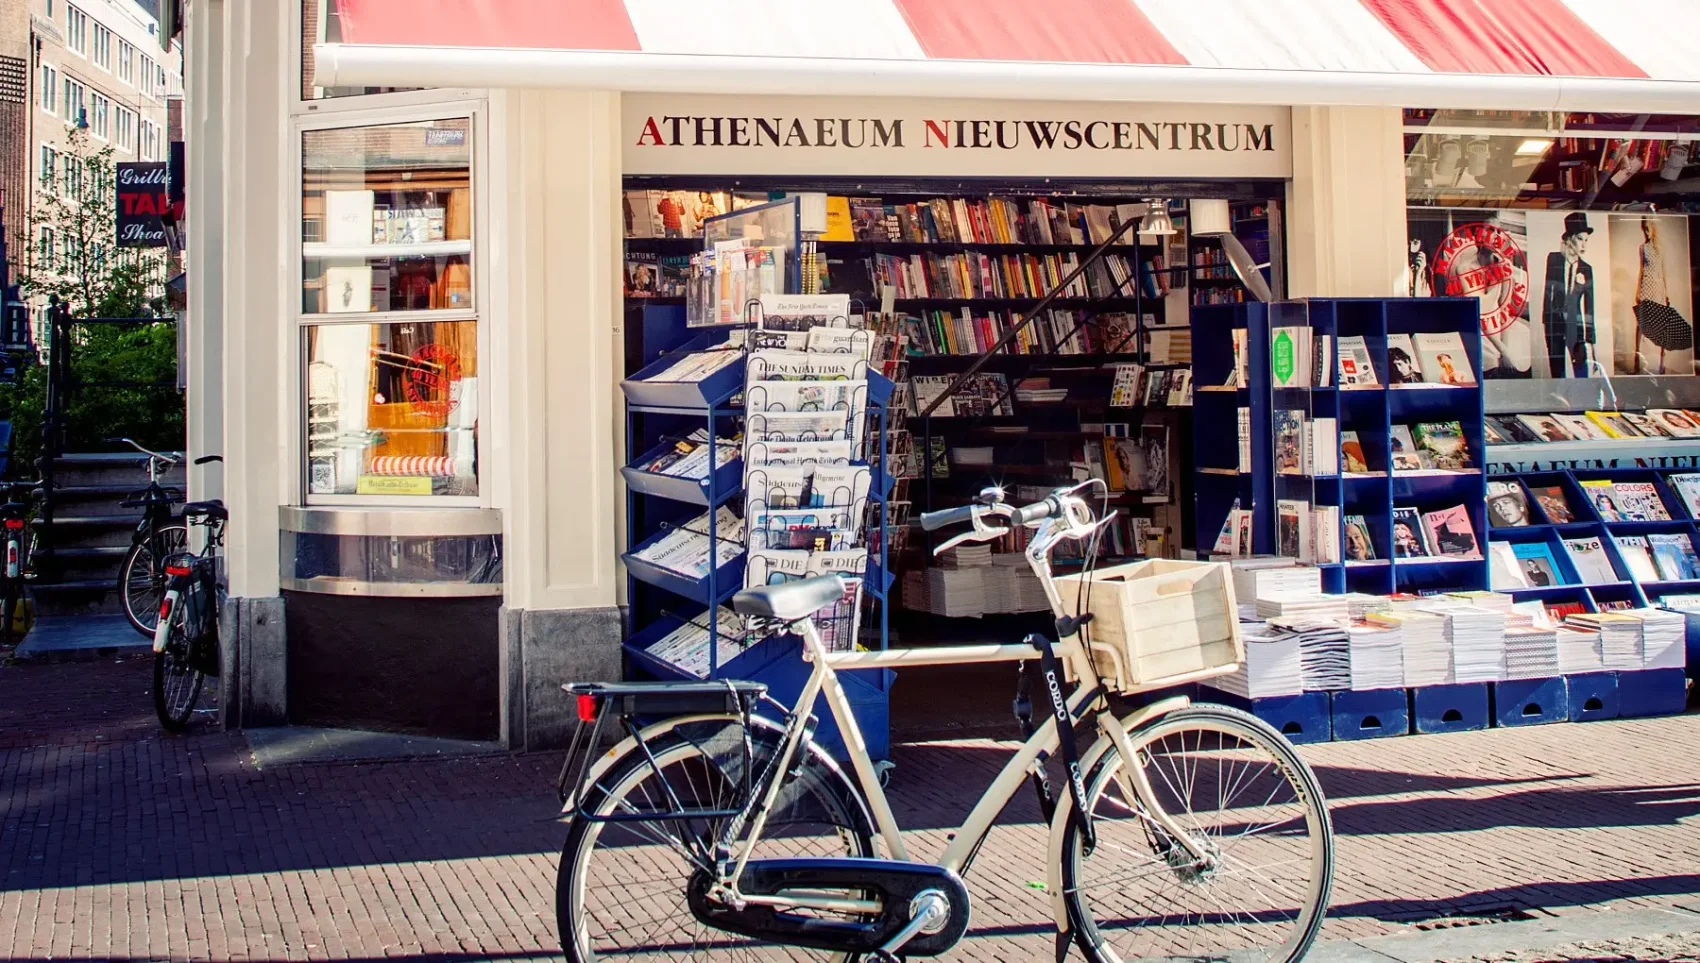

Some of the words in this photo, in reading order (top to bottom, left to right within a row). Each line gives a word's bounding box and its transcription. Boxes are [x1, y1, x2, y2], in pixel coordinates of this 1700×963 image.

[636, 116, 905, 148] ATHENAEUM
[922, 119, 1275, 151] NIEUWSCENTRUM
[1435, 227, 1517, 273] MAGAZINE
[1464, 263, 1514, 288] YEARS
[832, 333, 868, 343] guardian
[778, 363, 816, 374] SUNDAY
[818, 364, 846, 374] TIMES
[1614, 484, 1654, 493] COLORS
[1046, 671, 1067, 721] CORDO
[1070, 762, 1088, 812] CORDO
